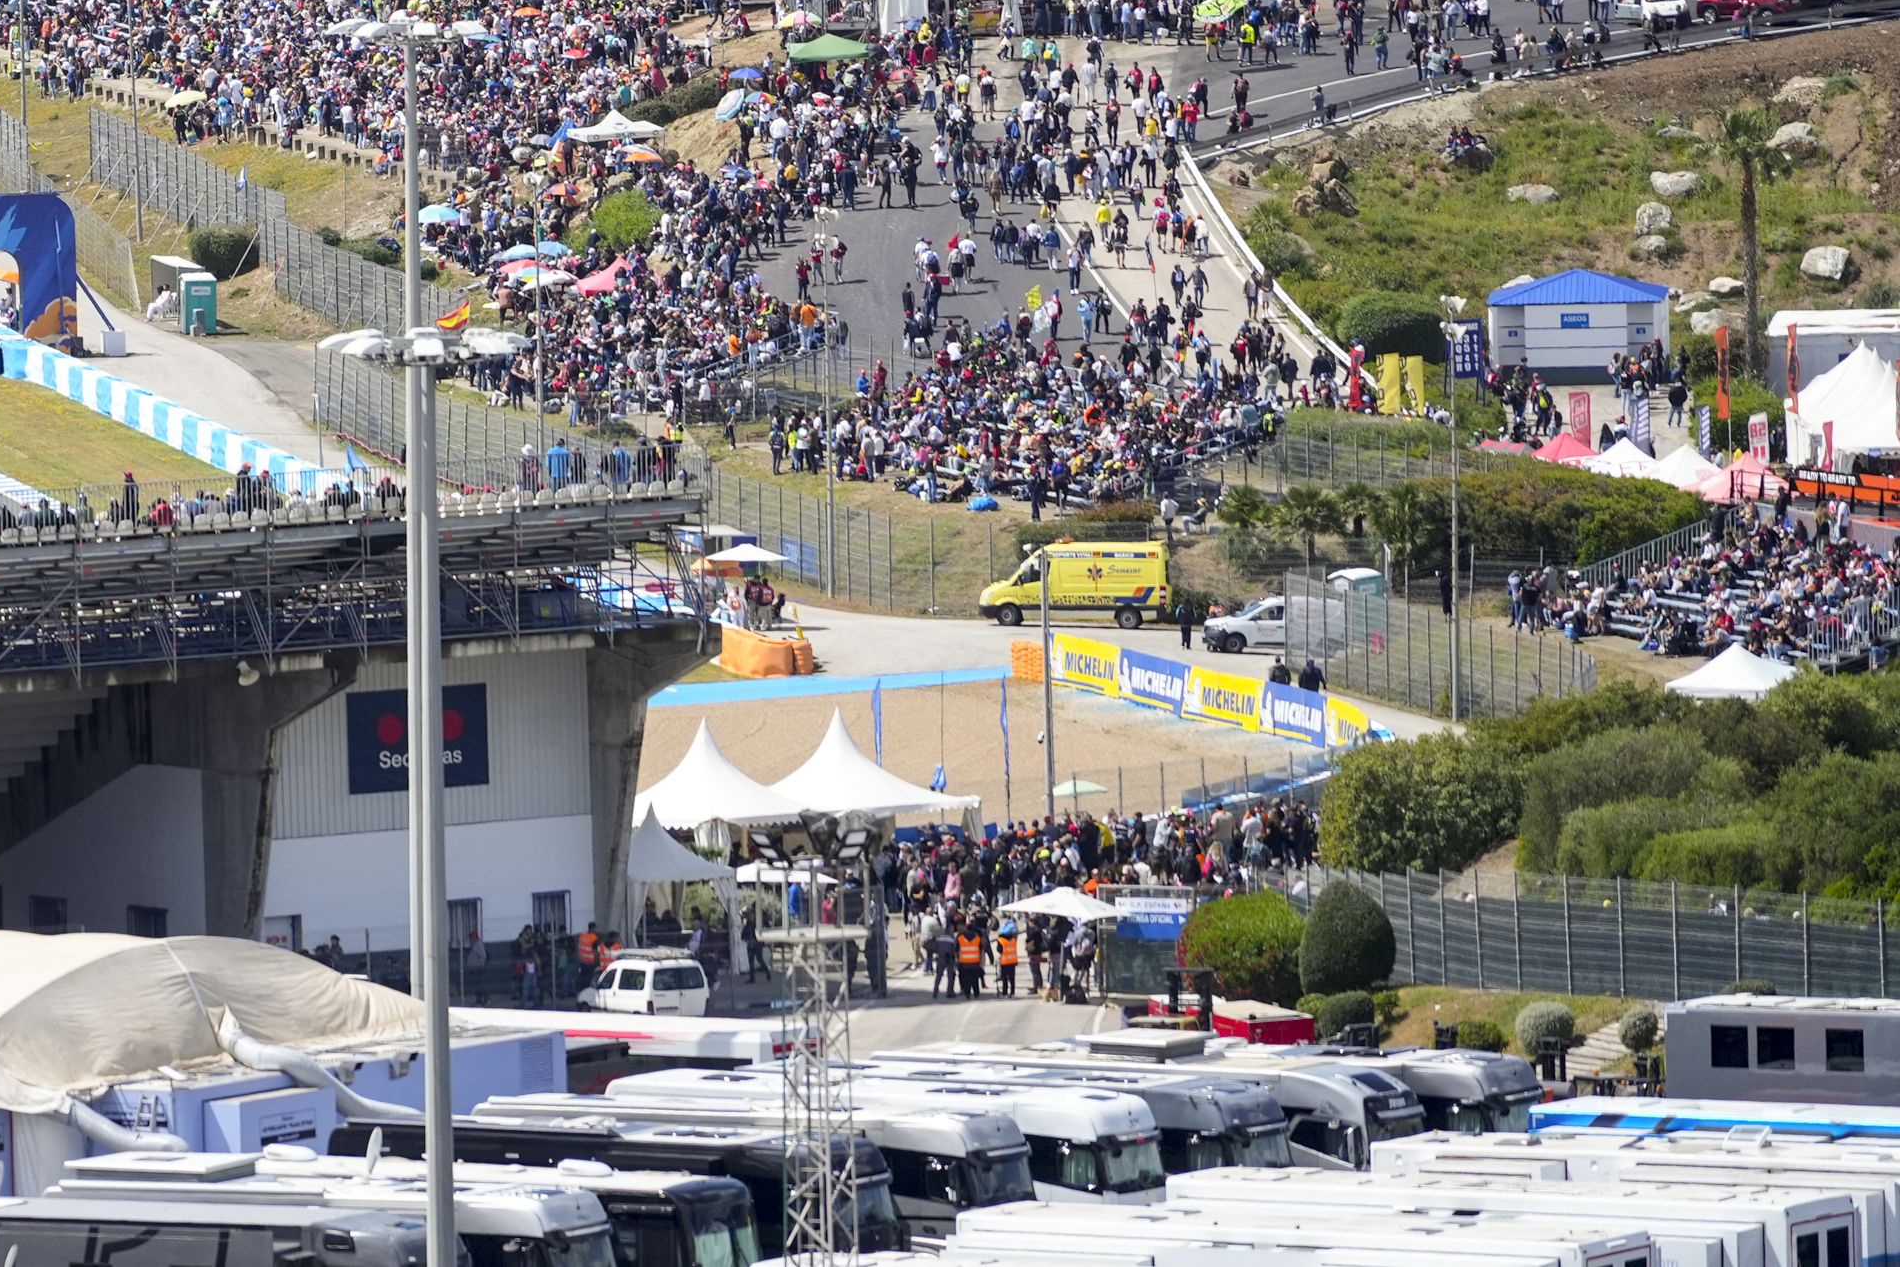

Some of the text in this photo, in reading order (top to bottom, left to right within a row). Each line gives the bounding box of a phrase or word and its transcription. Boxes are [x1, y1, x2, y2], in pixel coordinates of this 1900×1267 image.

[1799, 470, 1818, 482] READY
[1820, 472, 1828, 482] TO
[1064, 652, 1114, 681] MICHELIN
[1130, 667, 1182, 700] MICHELIN
[1202, 688, 1254, 716] MICHELIN
[1274, 699, 1322, 733] MICHELIN
[379, 750, 463, 768] Secas
[1150, 914, 1175, 925] OFICIAL
